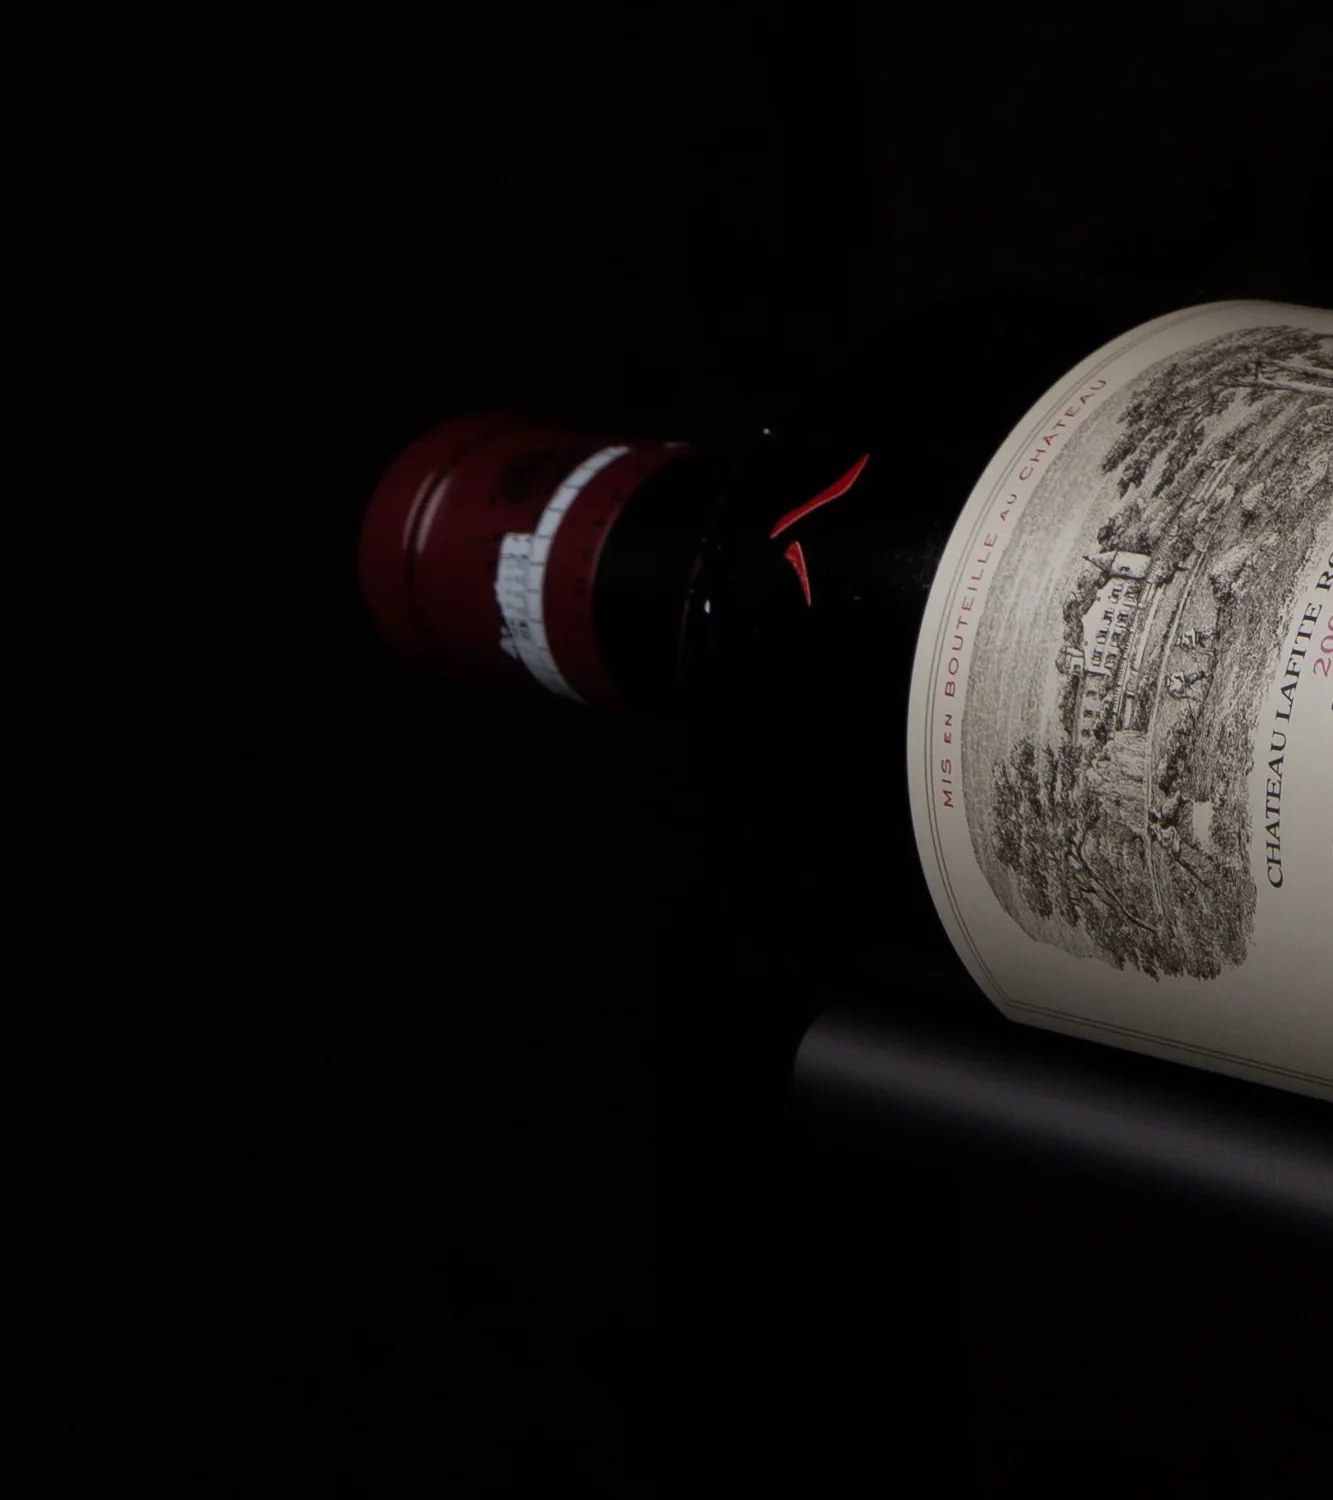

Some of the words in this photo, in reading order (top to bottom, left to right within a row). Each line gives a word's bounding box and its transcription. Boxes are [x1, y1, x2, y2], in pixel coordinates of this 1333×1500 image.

[943, 531, 999, 699] BOUTEILLE
[1274, 601, 1323, 726] LAFITE
[939, 756, 956, 810] MIS
[1264, 730, 1289, 890] CHATEAU
